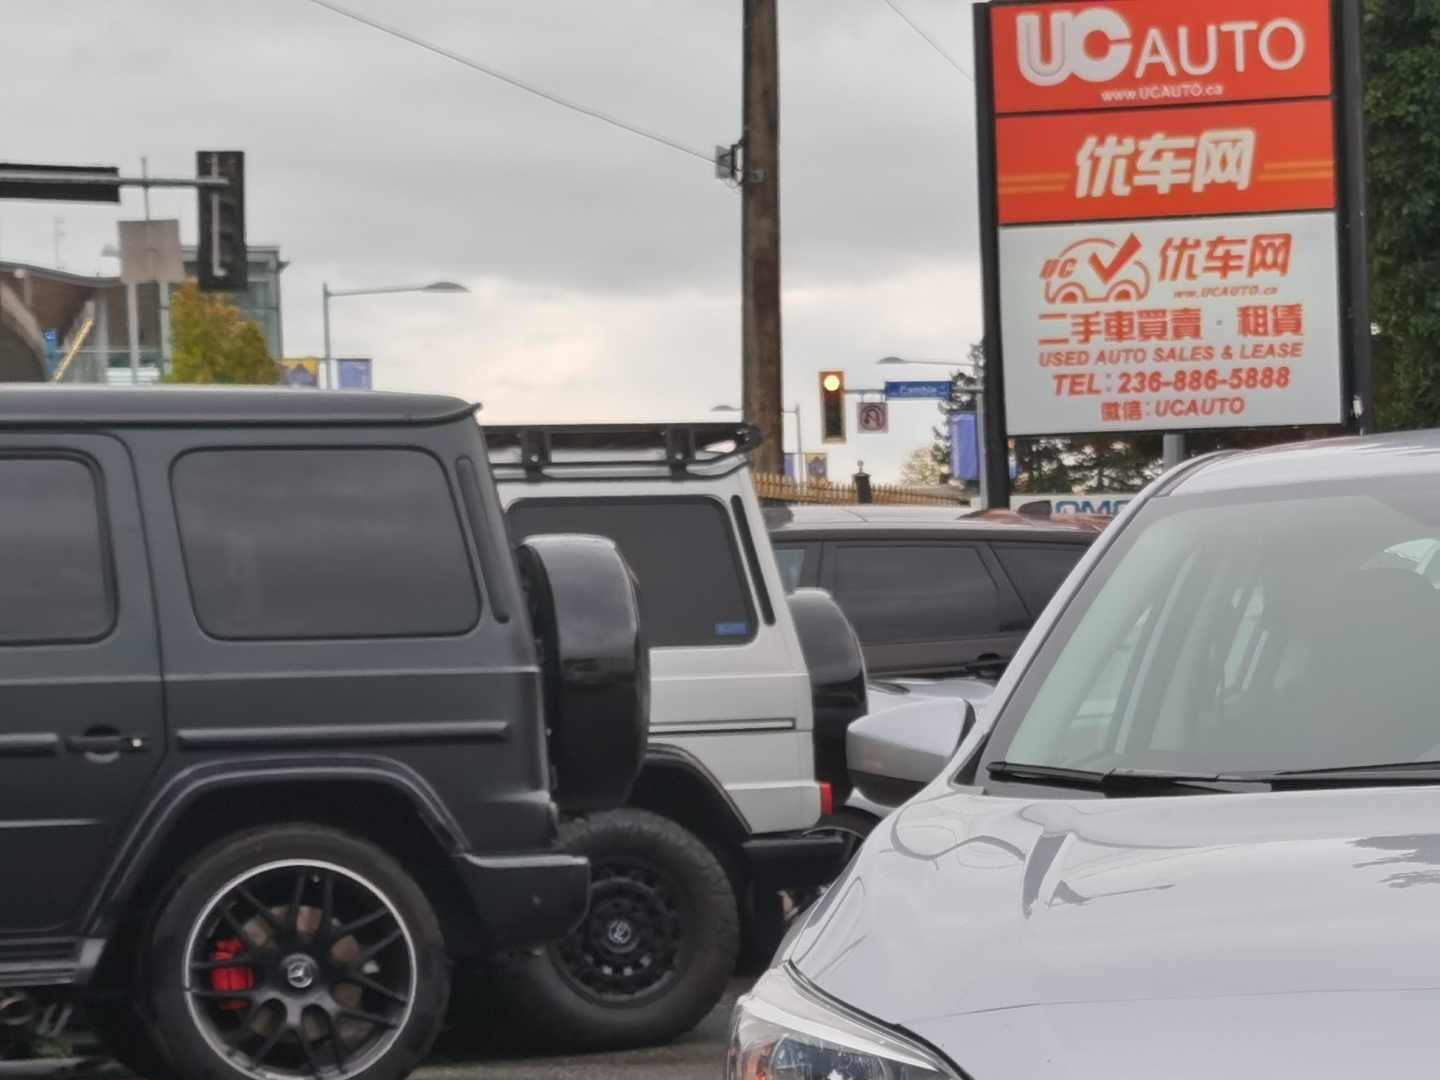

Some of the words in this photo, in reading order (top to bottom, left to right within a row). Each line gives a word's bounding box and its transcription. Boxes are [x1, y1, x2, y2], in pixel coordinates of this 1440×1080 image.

[1135, 17, 1305, 79] AUTO
[1101, 83, 1224, 102] www.UCAUTO.ca
[1075, 128, 1256, 199] 优车网
[1039, 257, 1078, 280] UC
[1158, 232, 1293, 282] 优车网
[1038, 307, 1203, 346] 二手車買賣
[1236, 303, 1304, 337] 租賃
[1038, 350, 1090, 368] USED
[1095, 348, 1147, 365] AUTO
[1152, 345, 1215, 363] SALES
[1219, 345, 1234, 360] &
[1238, 342, 1304, 360] LEASE
